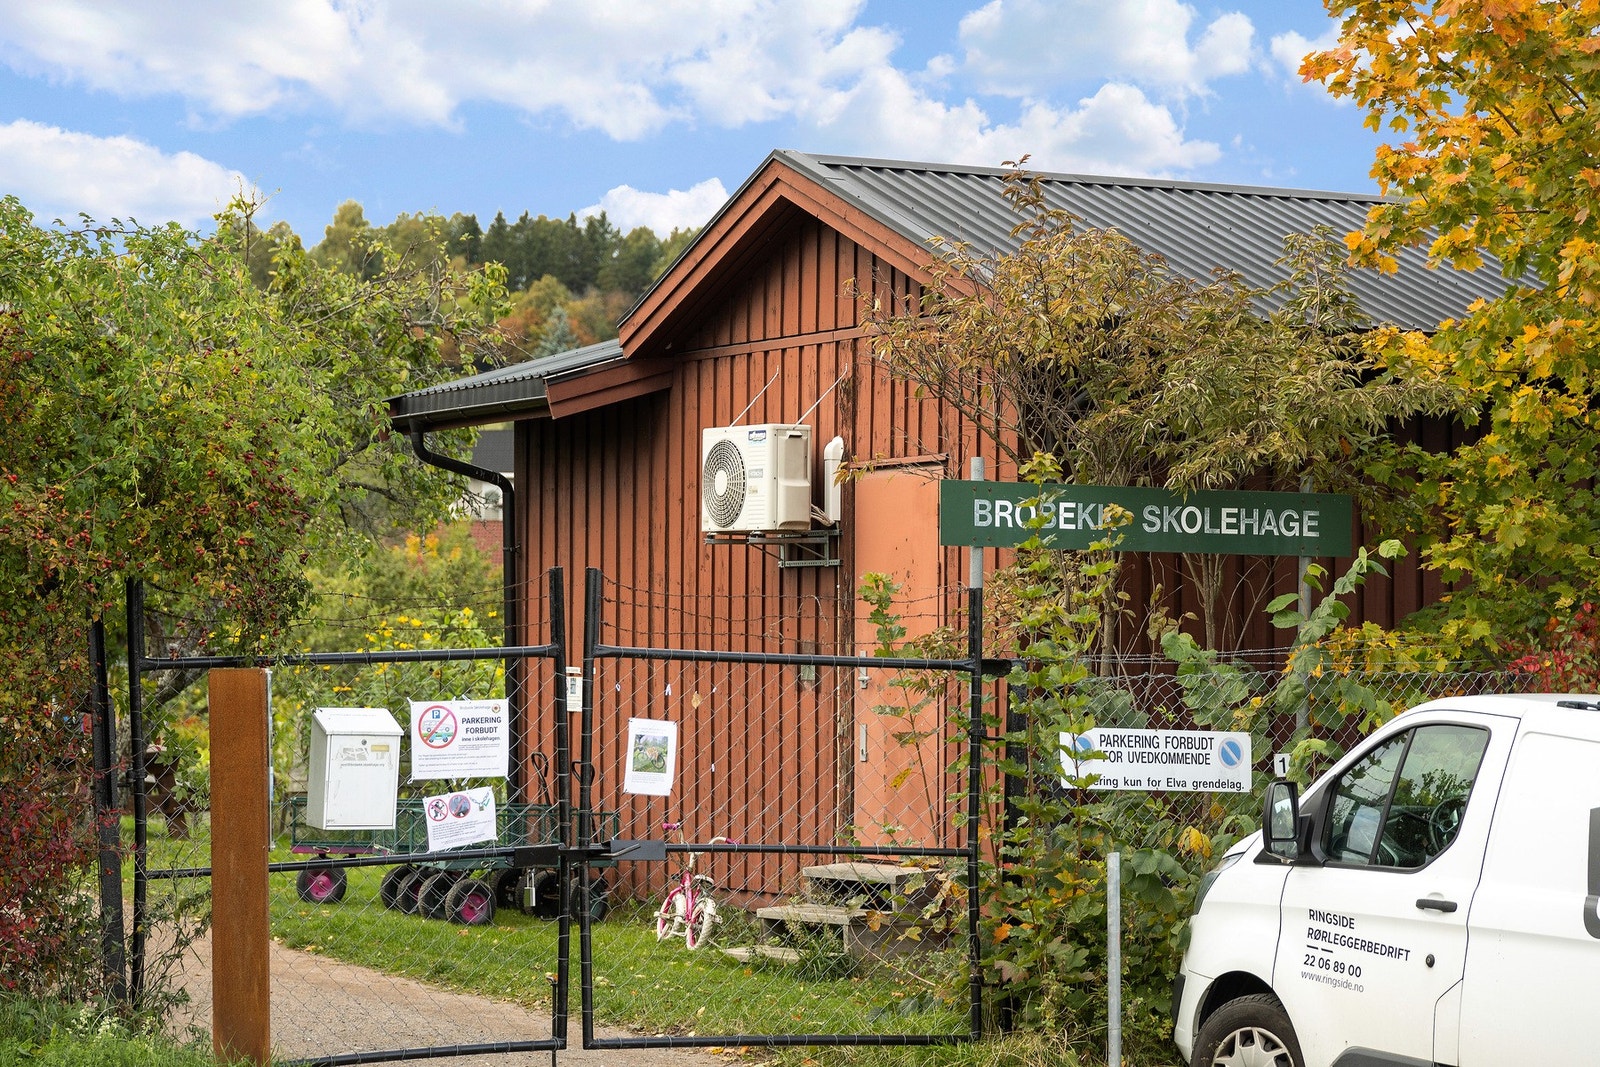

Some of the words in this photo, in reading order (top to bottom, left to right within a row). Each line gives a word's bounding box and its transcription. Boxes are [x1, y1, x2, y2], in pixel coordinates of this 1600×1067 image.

[1142, 505, 1319, 537] SKOLEHAGE
[465, 726, 498, 735] FORBUDT
[1099, 734, 1160, 749] PARKERING
[1165, 736, 1214, 751] FORBUDT
[1127, 751, 1211, 765] UVEDKOMMENDE
[1124, 776, 1142, 787] kun
[1148, 777, 1161, 788] for
[1166, 778, 1187, 788] Elva
[1192, 779, 1245, 791] grendelag.
[1309, 909, 1355, 929] RINGSIDE
[1307, 927, 1410, 961] RØRLEGGERBEDRIFT
[1303, 954, 1316, 967] 22
[1318, 957, 1331, 970] 06
[1333, 961, 1346, 974] 89
[1348, 964, 1362, 978] 00
[1301, 970, 1364, 993] www.ringside.no
